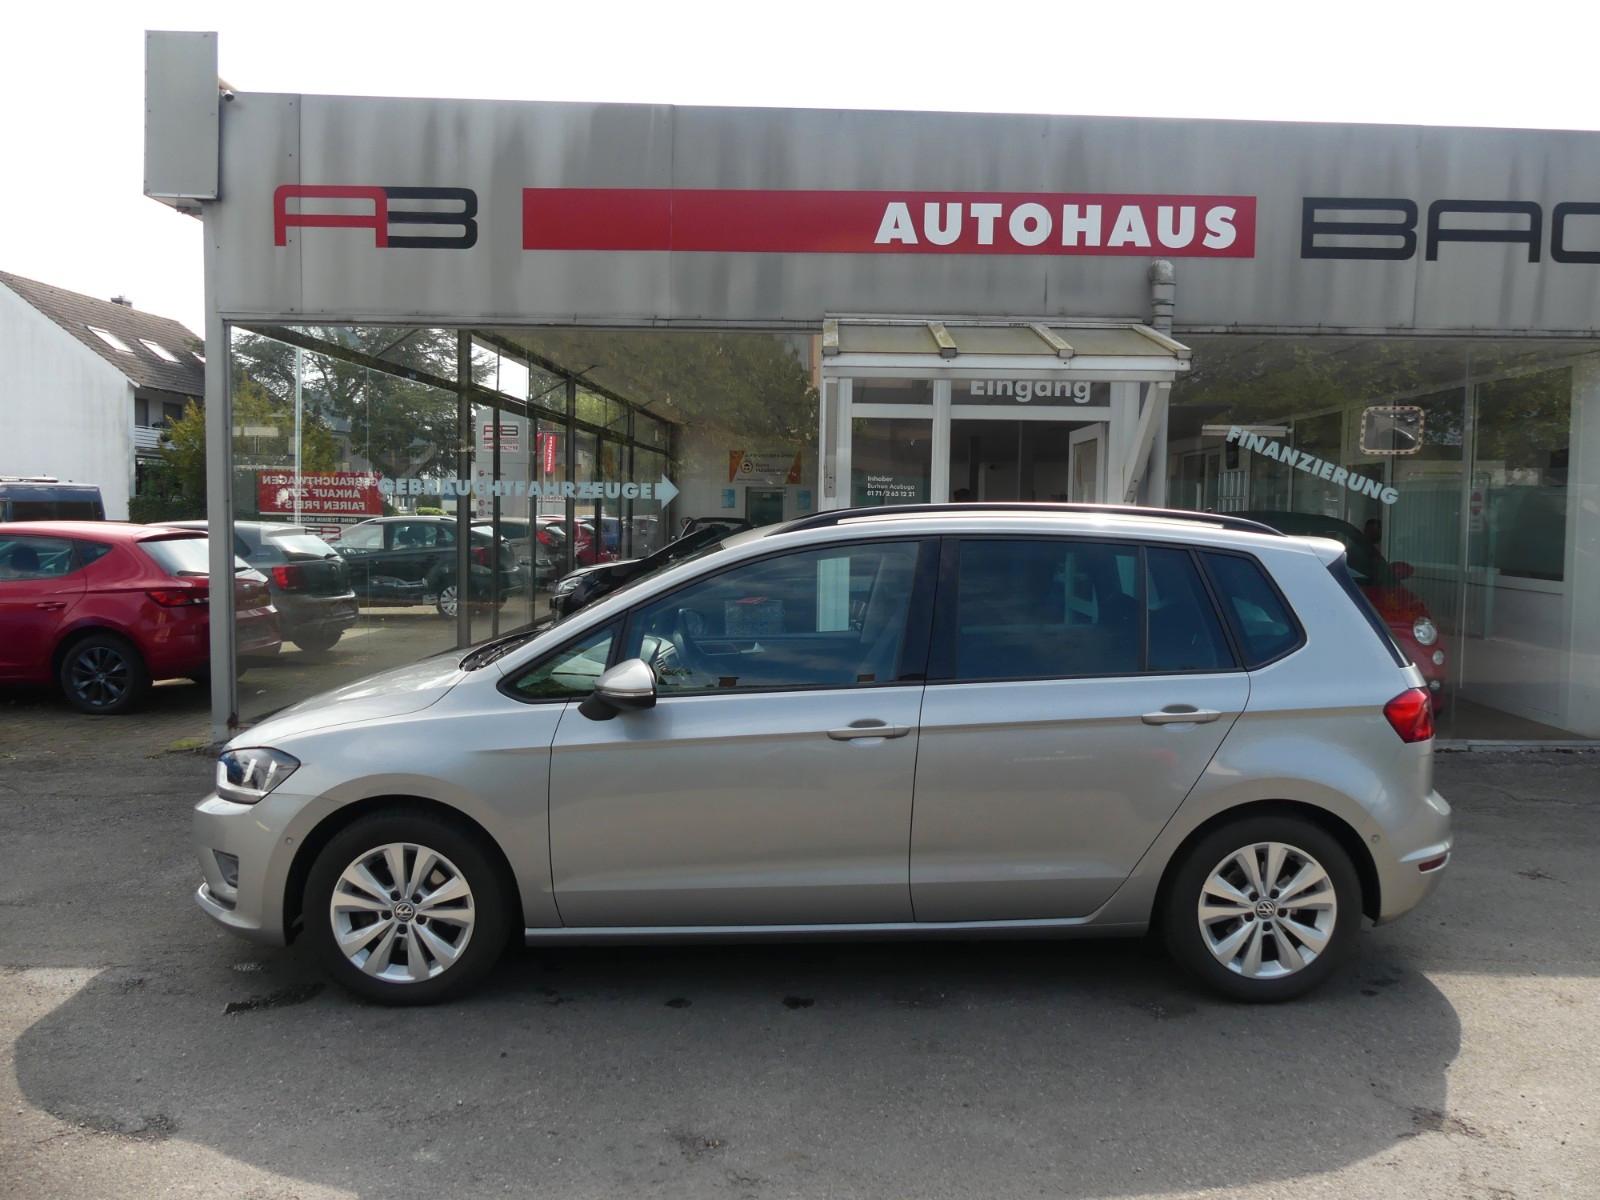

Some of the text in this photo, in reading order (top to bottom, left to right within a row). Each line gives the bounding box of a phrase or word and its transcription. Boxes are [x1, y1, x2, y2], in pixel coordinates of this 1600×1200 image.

[274, 184, 478, 249] AB
[873, 201, 1237, 250] AUTOHAUS
[969, 379, 1092, 404] Eingang
[377, 477, 653, 500] GEBRAUCHTFAHRZEUGE
[1225, 425, 1399, 505] FINANZIERUNG
